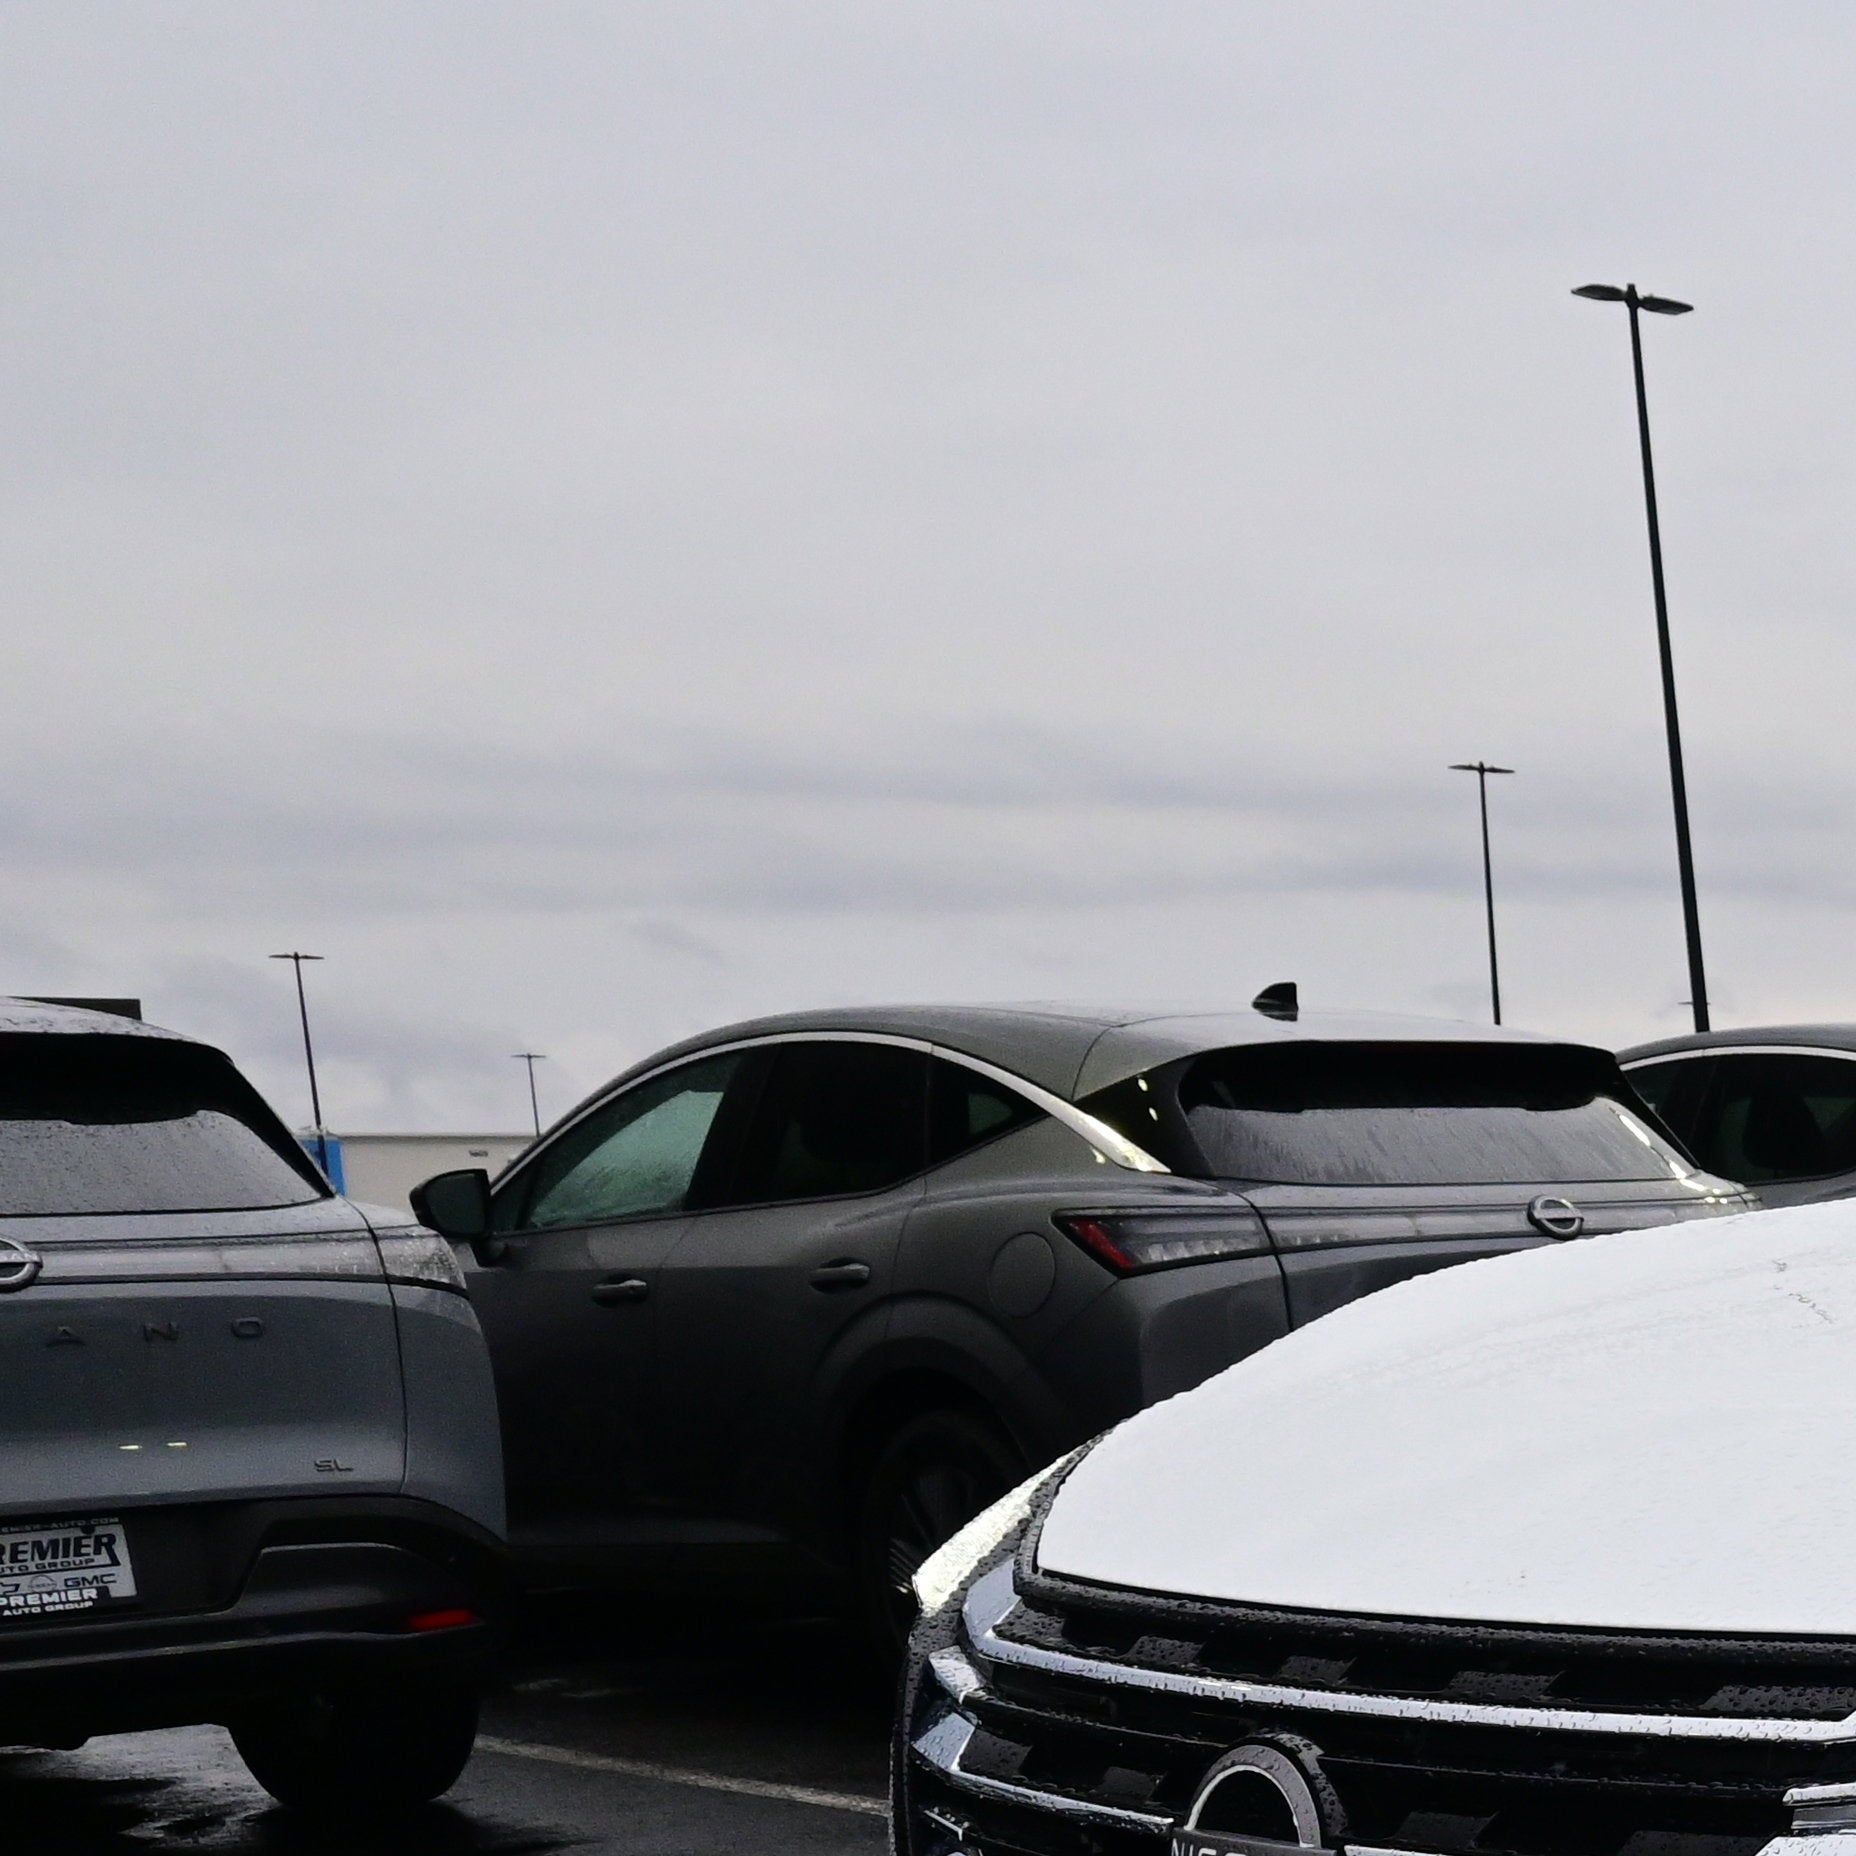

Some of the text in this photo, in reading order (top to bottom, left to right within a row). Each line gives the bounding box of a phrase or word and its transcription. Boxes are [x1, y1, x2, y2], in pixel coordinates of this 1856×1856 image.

[314, 1458, 354, 1473] SL
[0, 1533, 121, 1566] EMIER
[36, 1558, 96, 1570] GROUP
[64, 1574, 118, 1588] GMC
[2, 1600, 94, 1616] AUTO GROUP
